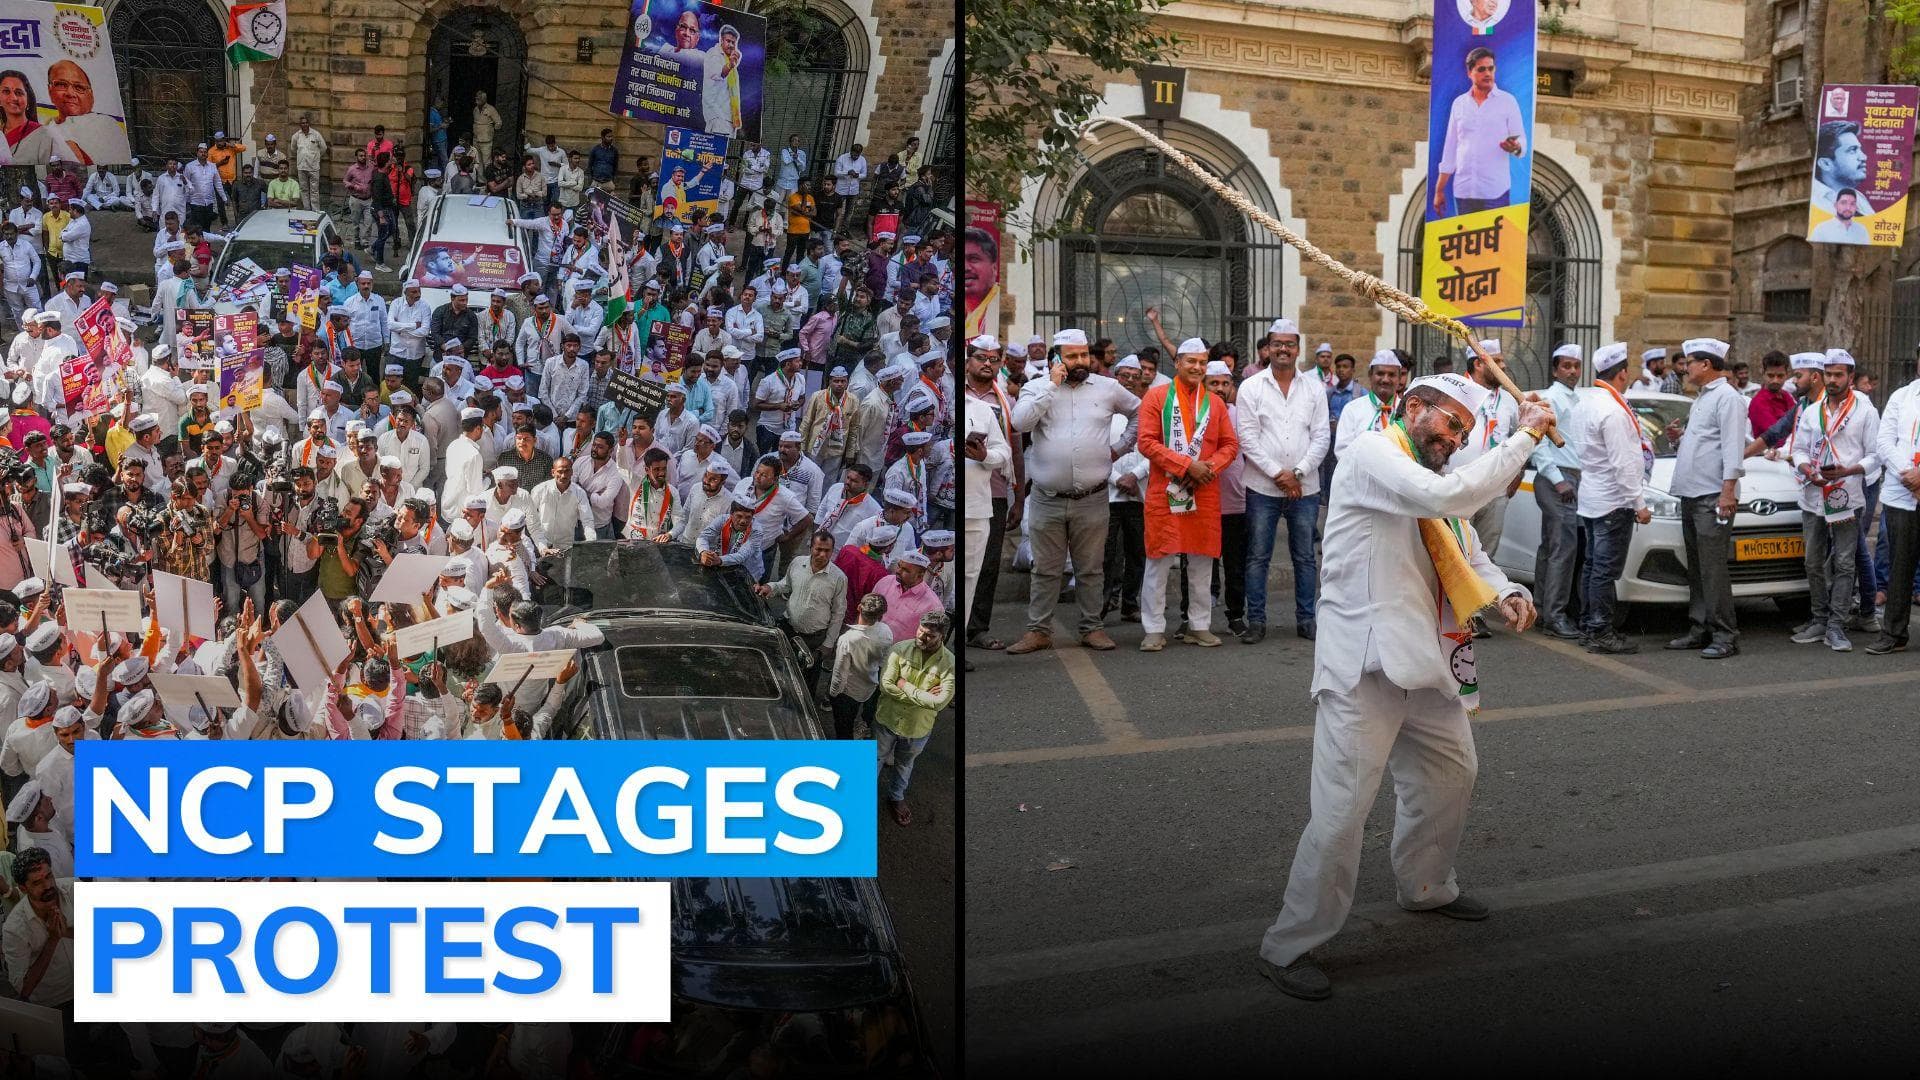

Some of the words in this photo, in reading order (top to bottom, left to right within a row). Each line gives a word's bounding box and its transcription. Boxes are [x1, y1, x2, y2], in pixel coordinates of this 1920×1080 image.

[682, 78, 698, 91] आहे
[676, 106, 691, 118] आहे
[1889, 104, 1915, 118] साहेब
[1438, 215, 1504, 261] संघर्ष
[1873, 231, 1897, 242] काळे
[1436, 266, 1501, 302] योद्धा
[1743, 540, 1806, 556] MH05DK317
